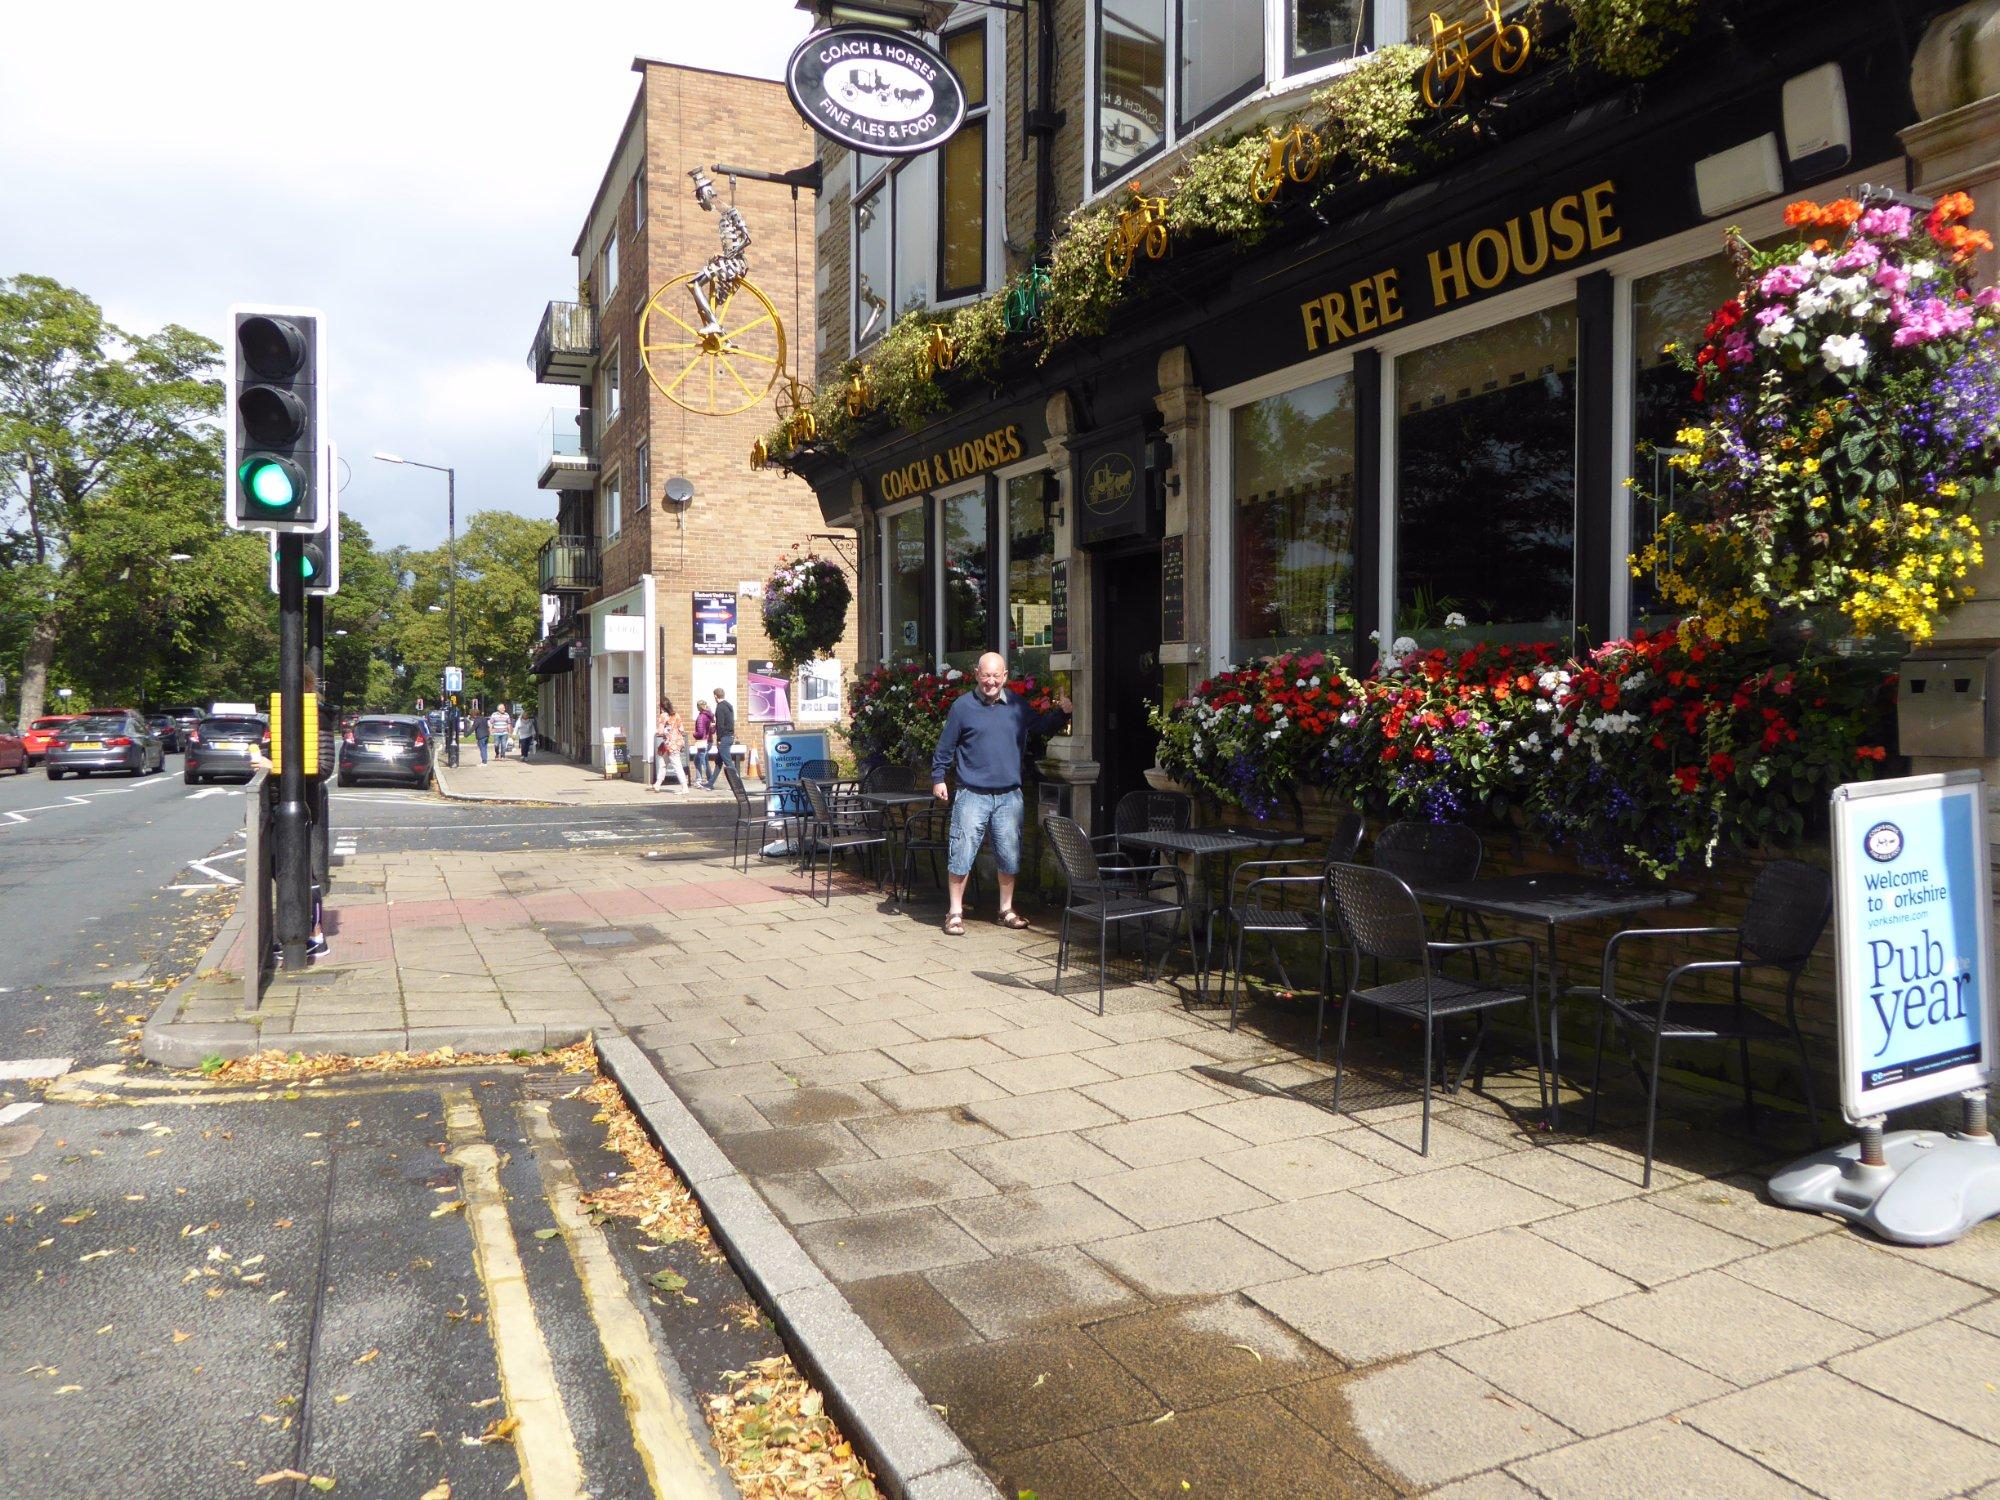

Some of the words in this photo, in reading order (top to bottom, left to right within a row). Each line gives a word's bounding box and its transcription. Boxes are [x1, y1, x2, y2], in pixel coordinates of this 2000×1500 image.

[819, 42, 869, 64] COACH
[873, 43, 883, 56] &
[886, 45, 937, 82] HORSES
[819, 97, 849, 127] FINE
[852, 119, 885, 138] ALES
[889, 125, 899, 138] &
[901, 113, 937, 138] FOOD
[1300, 268, 1404, 351] FREE
[1427, 180, 1622, 308] HOUSE
[881, 458, 932, 501] COACH
[933, 454, 950, 484] &
[948, 425, 1021, 479] HORSES
[1864, 868, 1929, 891] Welcome
[1867, 896, 1883, 912] to
[1867, 910, 1929, 930] yorkshire.com
[1868, 928, 1944, 989] Pub
[1870, 972, 1971, 1057] year
